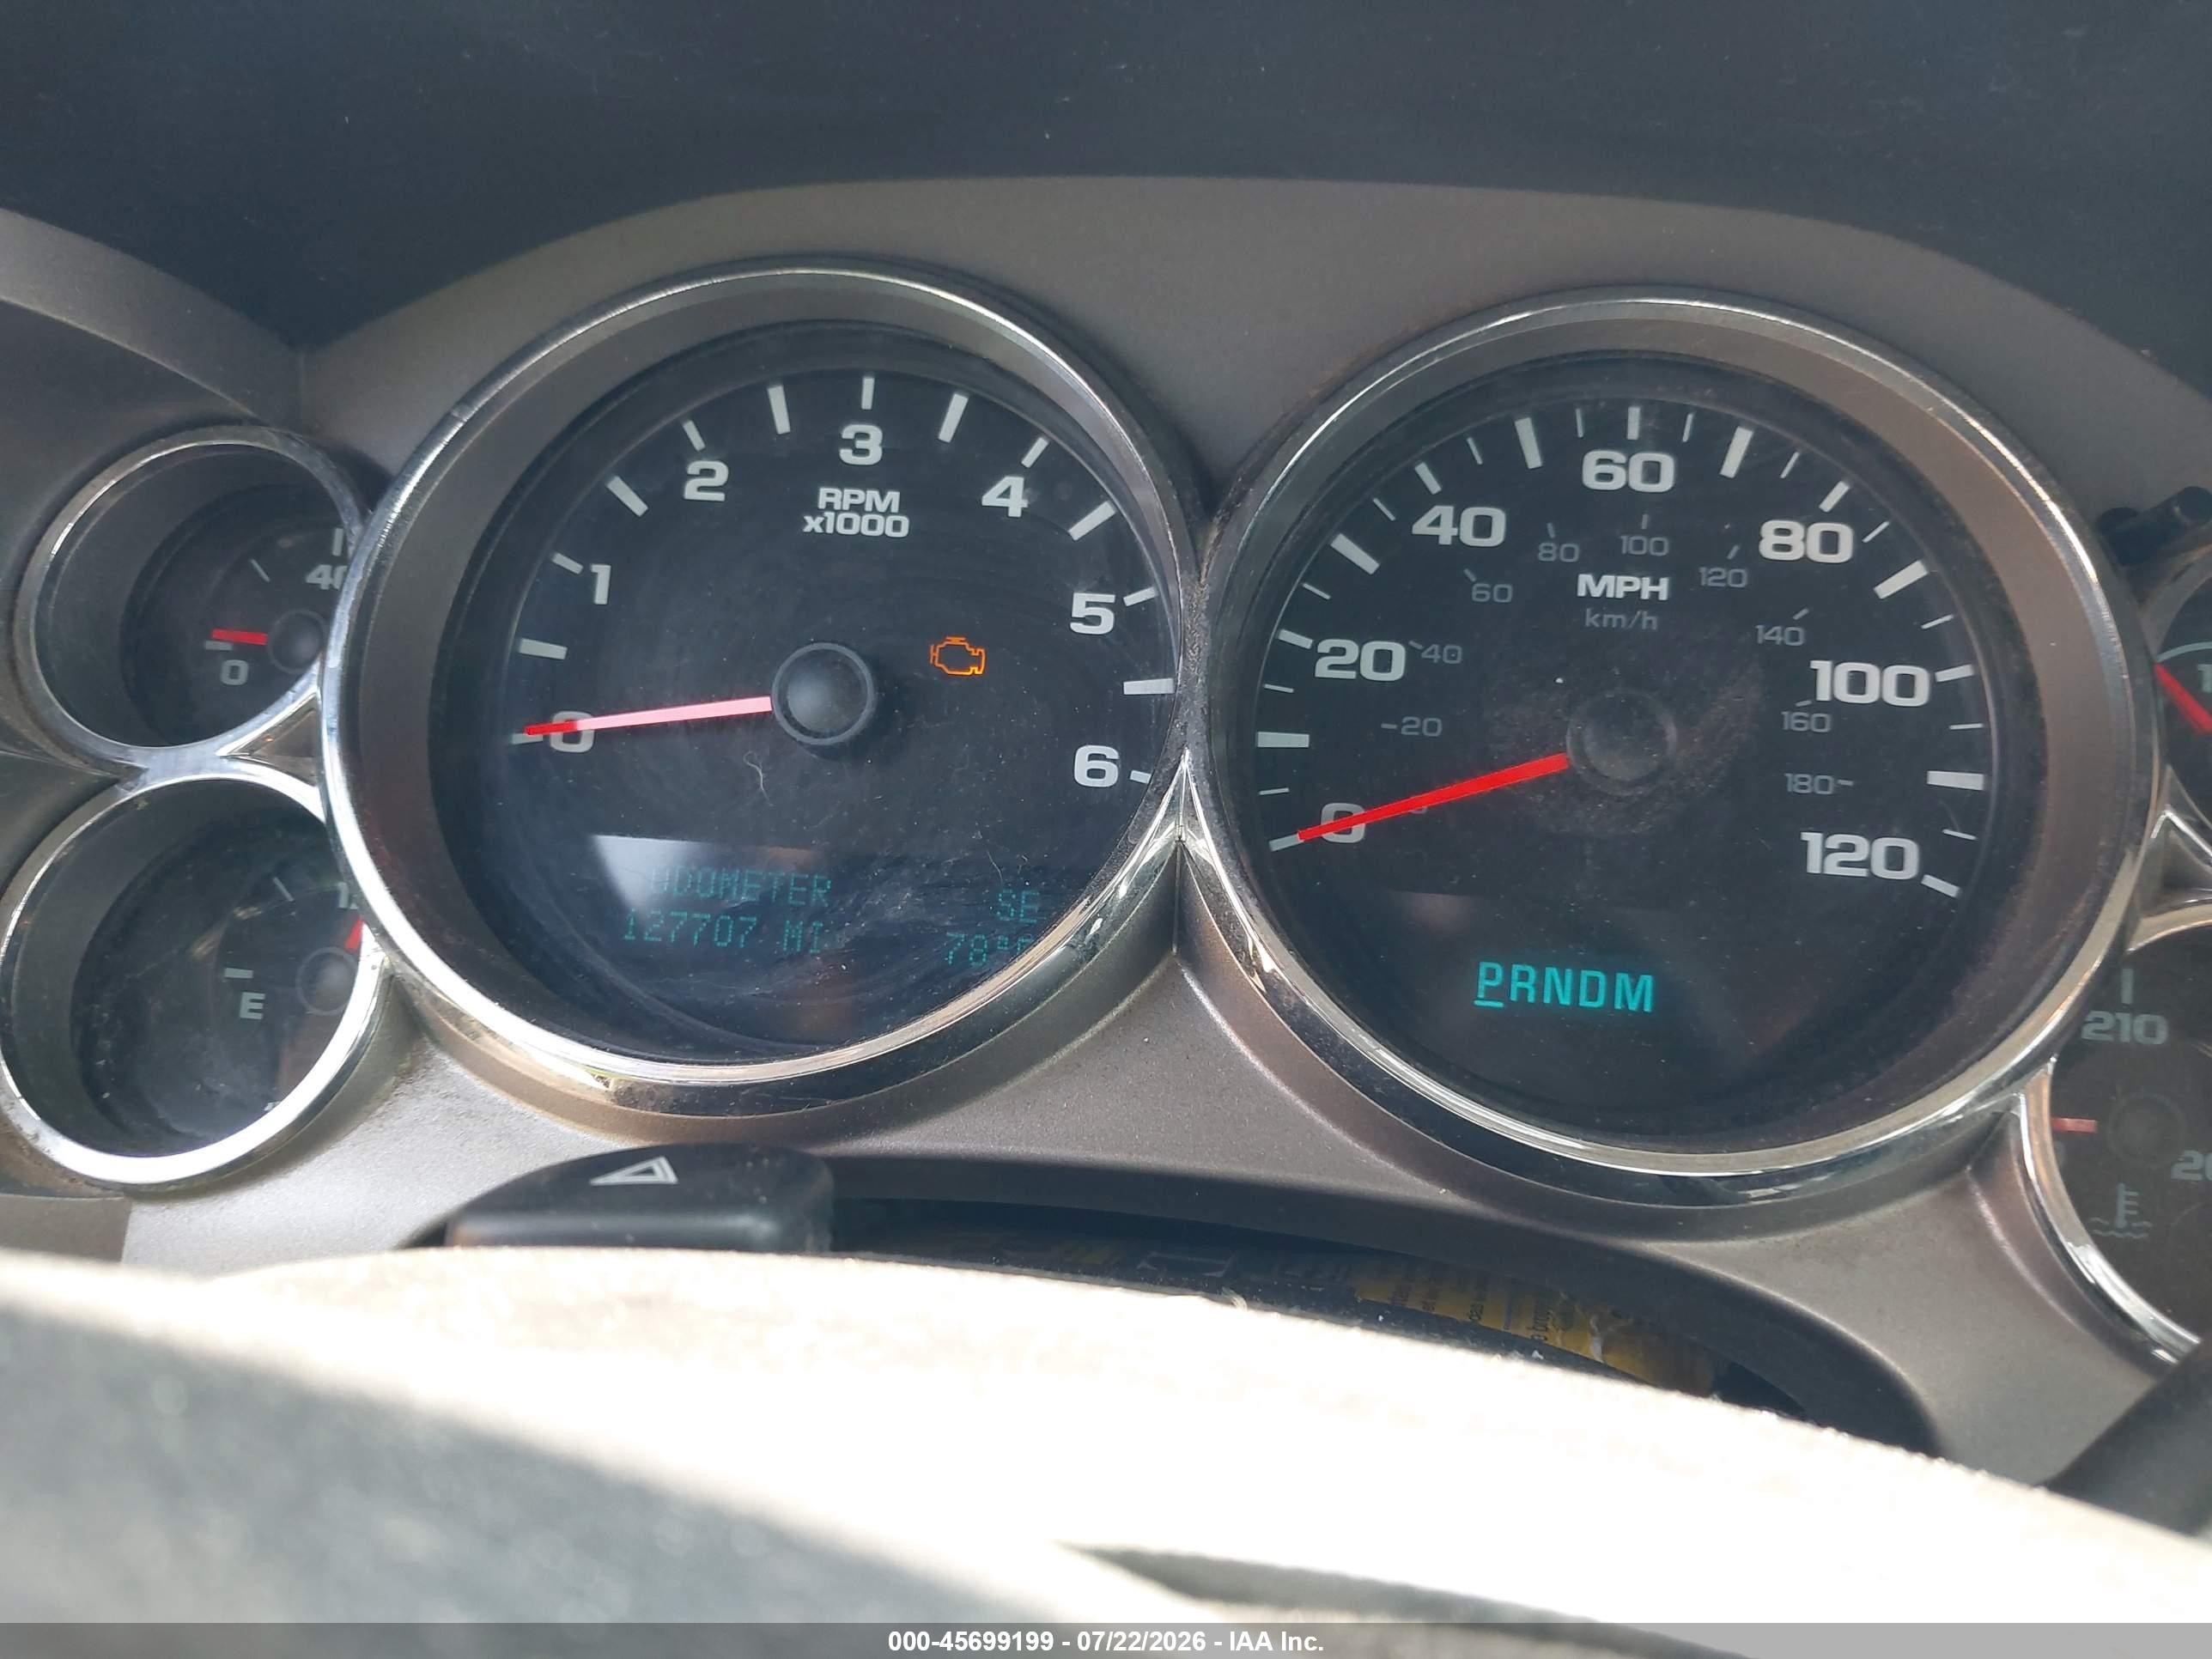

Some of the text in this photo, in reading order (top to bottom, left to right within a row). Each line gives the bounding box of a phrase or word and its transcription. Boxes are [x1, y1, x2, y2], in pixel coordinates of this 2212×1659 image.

[839, 425, 883, 465] 3
[684, 459, 729, 501] 2
[1582, 450, 1674, 493] 60
[818, 488, 900, 513] RPM
[982, 476, 1028, 518] 4
[803, 513, 909, 538] x1000
[1412, 505, 1506, 547] 40
[1759, 520, 1853, 563] 80
[1538, 543, 1580, 562] 80
[1621, 535, 1669, 556] 100
[590, 563, 611, 605] 1
[1471, 584, 1512, 603] 60
[1577, 574, 1668, 600] MPH
[1699, 567, 1747, 587] 120
[1069, 592, 1115, 635] 5
[1584, 608, 1658, 630] km/h
[1756, 624, 1805, 646] 140
[1315, 639, 1406, 681] 20
[1421, 645, 1462, 664] 40
[221, 662, 248, 685] 0
[1810, 659, 1930, 707] 100
[550, 711, 594, 752] 0
[1401, 716, 1443, 737] 20
[1782, 711, 1832, 732] 160
[1074, 745, 1119, 787] 6
[1785, 773, 1834, 795] 180
[1321, 803, 1365, 843] 0
[1801, 831, 1920, 880] 120
[997, 889, 1039, 923] SE
[623, 908, 823, 953] 127707 MI
[240, 991, 265, 1020] E
[2081, 1011, 2169, 1045] 210
